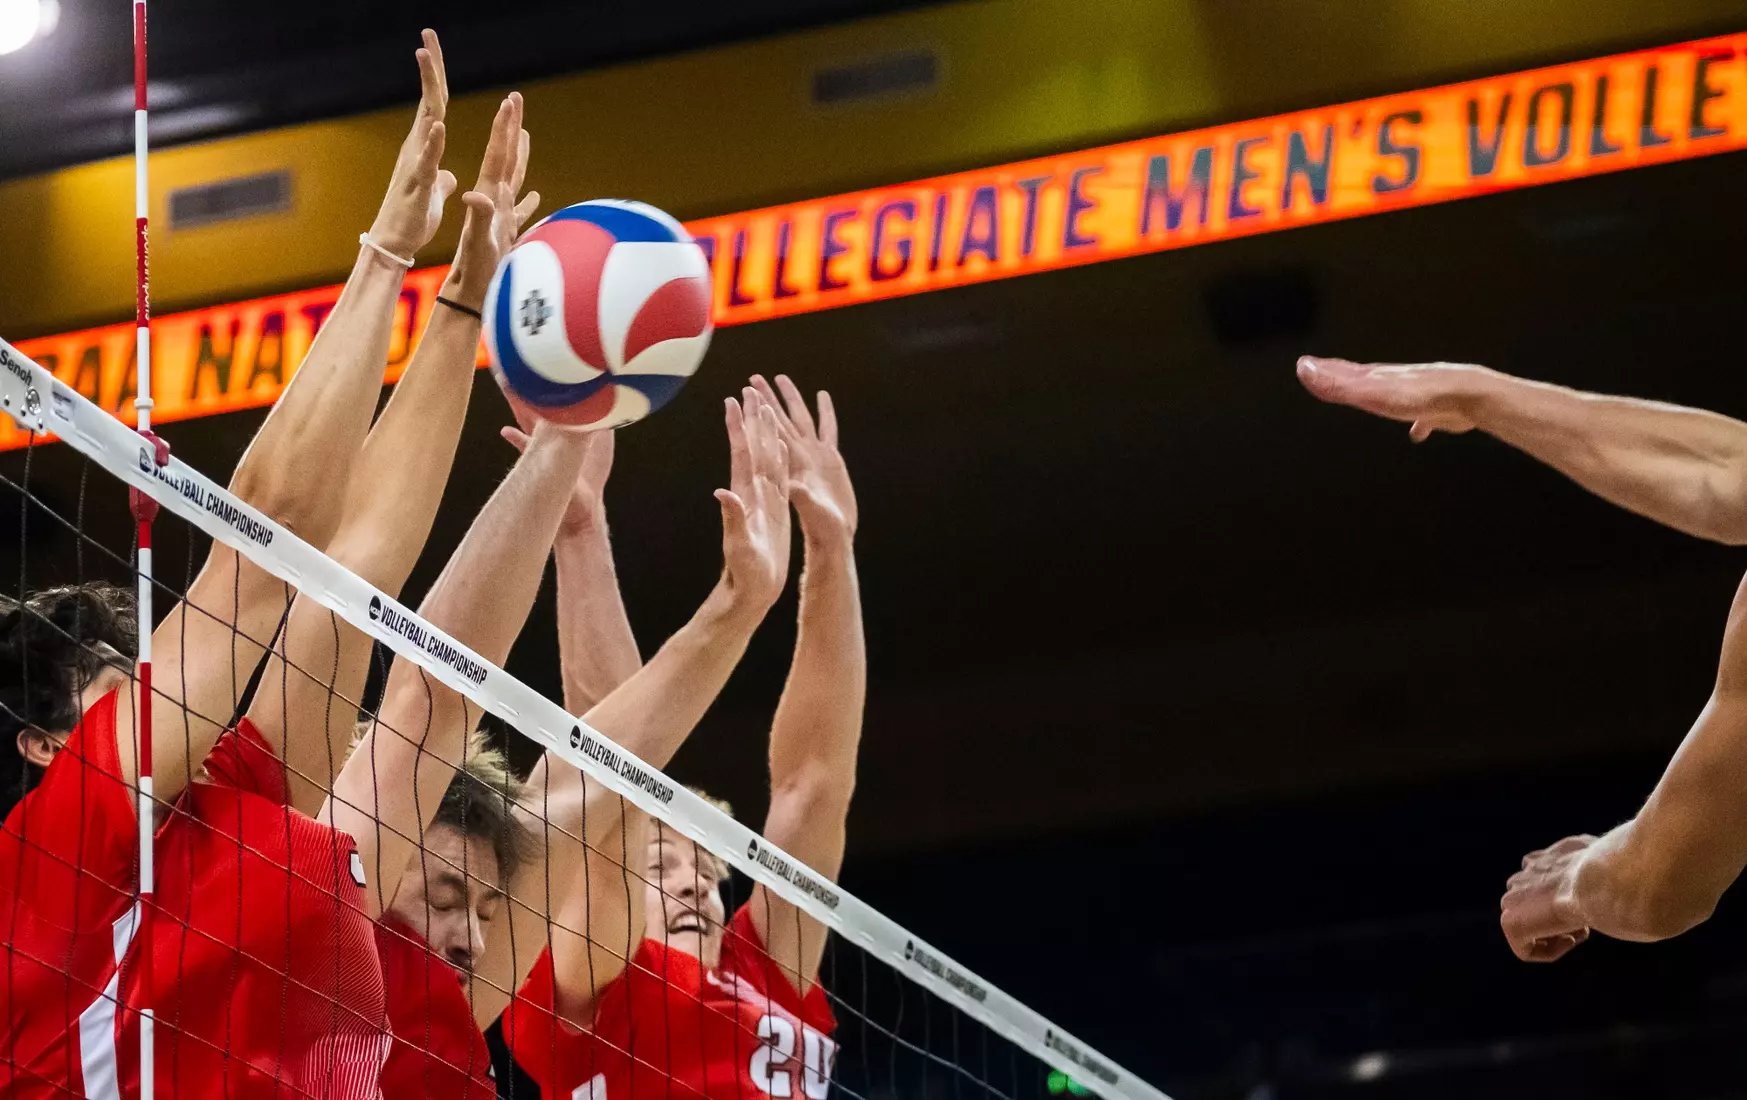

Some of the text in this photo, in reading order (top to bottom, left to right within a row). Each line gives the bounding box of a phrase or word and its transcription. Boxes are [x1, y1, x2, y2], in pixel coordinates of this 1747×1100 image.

[694, 166, 1104, 306] LLEGIATE
[1140, 110, 1422, 236] MEN'S
[0, 349, 34, 387] Senoh
[206, 492, 274, 548] CHAMPIONSHIP
[381, 605, 428, 649] VOLLEYBALL
[427, 636, 488, 685] CHAMPIONSHIP
[580, 734, 674, 805] VOLLEYBALL CHAMPIONSHIP
[749, 1014, 836, 1100] 20
